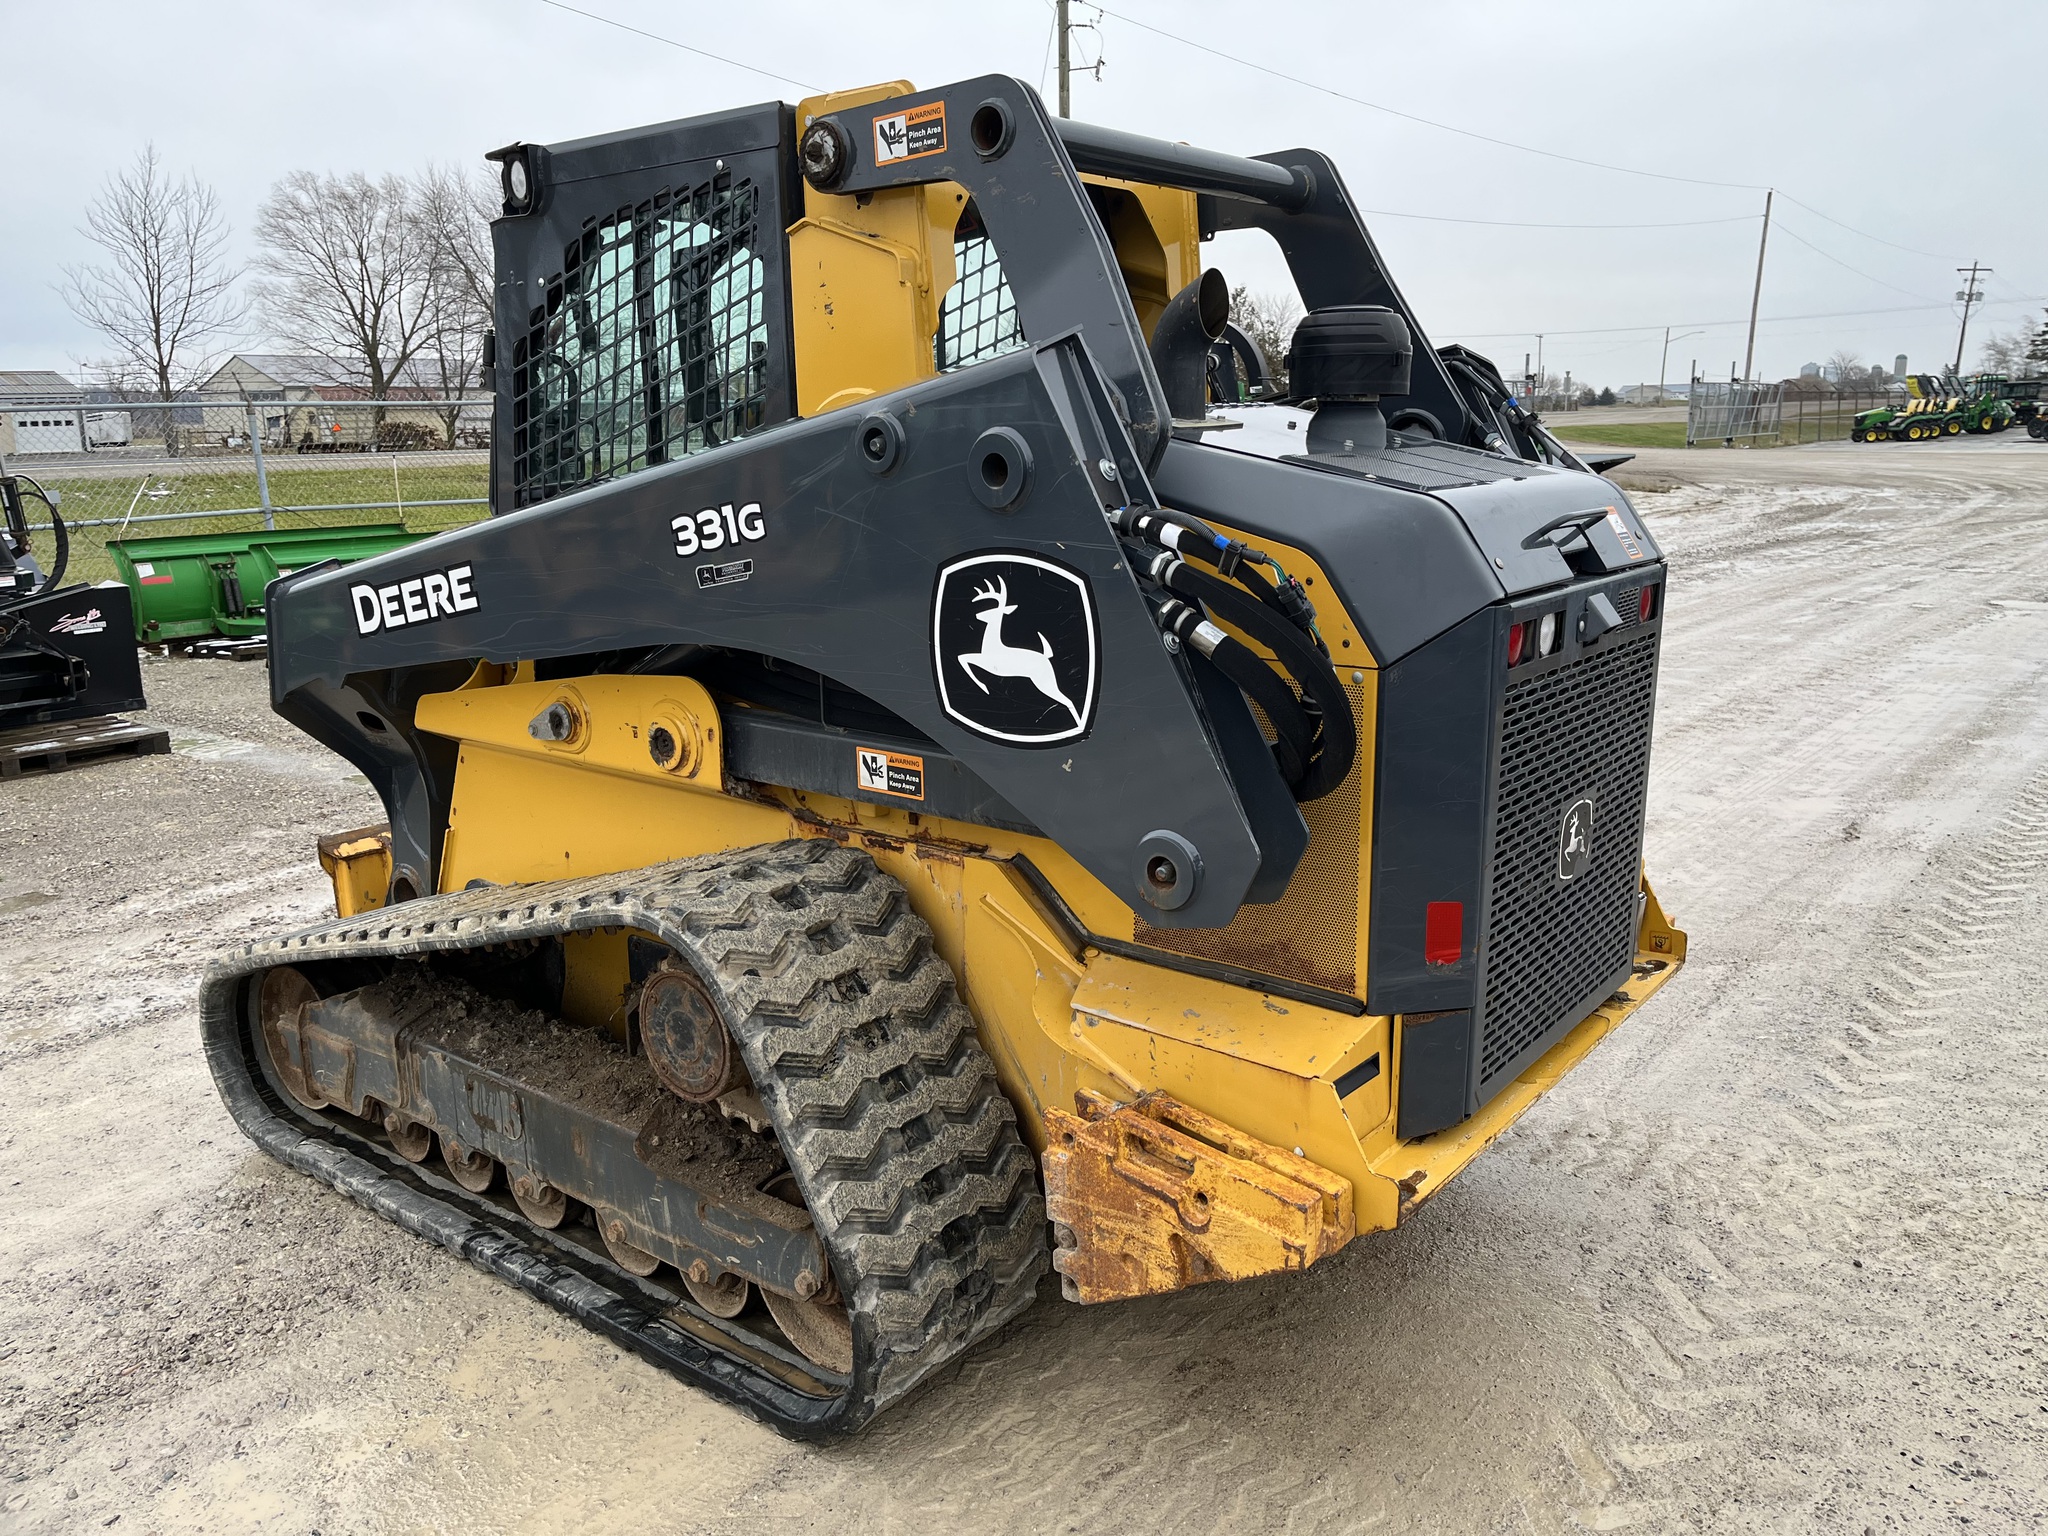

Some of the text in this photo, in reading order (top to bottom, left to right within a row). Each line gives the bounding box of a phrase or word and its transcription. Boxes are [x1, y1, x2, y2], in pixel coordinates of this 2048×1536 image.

[913, 107, 941, 119] WARNING
[908, 126, 942, 139] Pinch Area
[909, 137, 938, 149] Keep Away
[671, 503, 766, 556] 331G
[350, 565, 479, 634] DEERE
[894, 757, 920, 768] WARNING
[889, 771, 920, 783] Pinch Area
[889, 780, 916, 792] Keep Away
